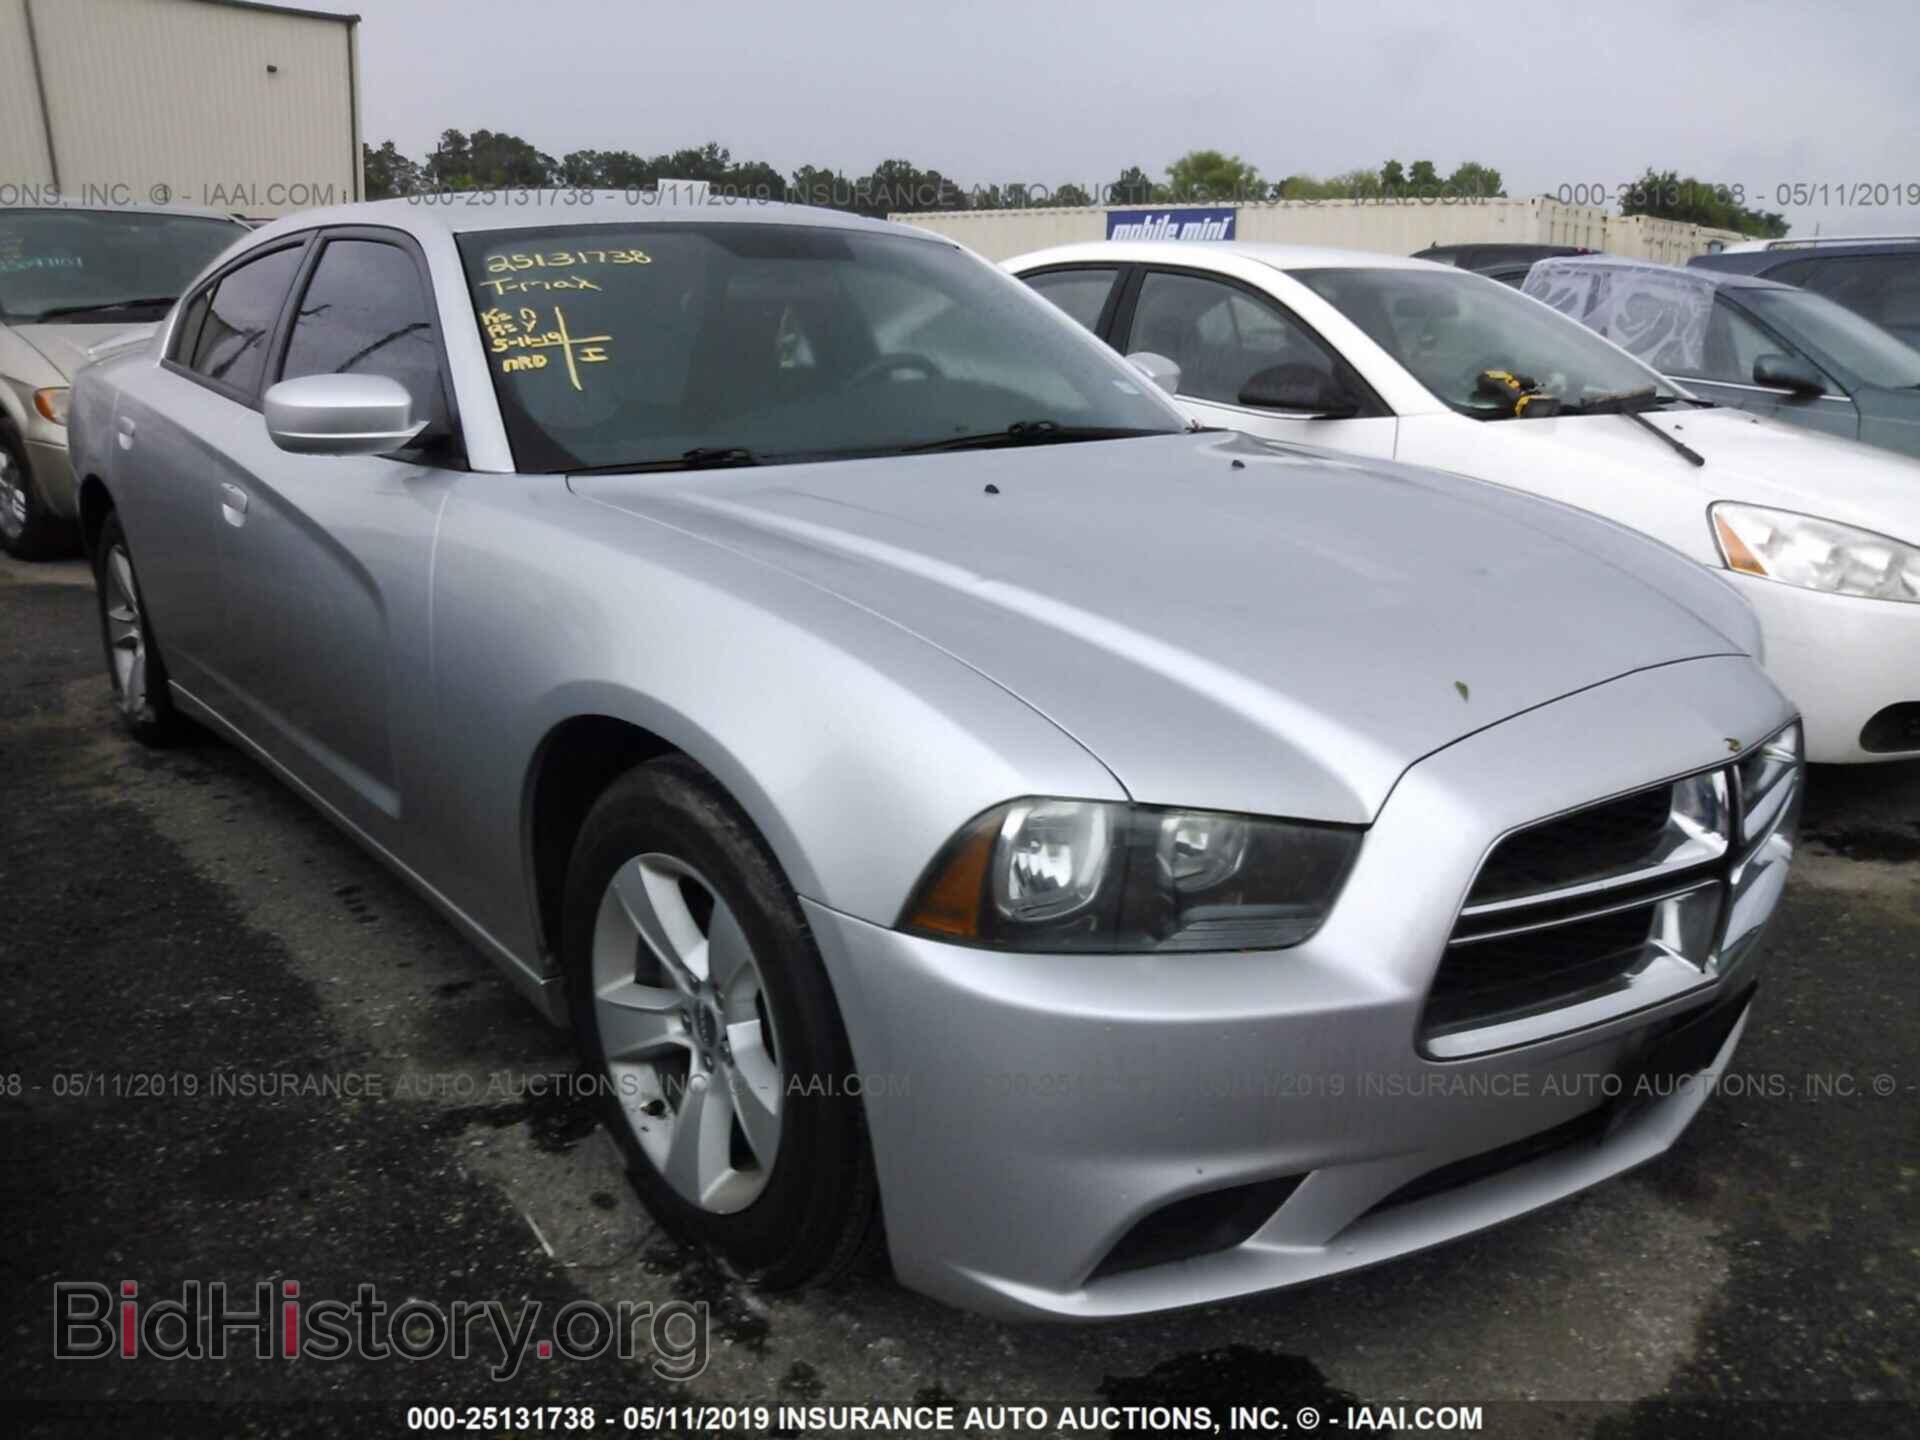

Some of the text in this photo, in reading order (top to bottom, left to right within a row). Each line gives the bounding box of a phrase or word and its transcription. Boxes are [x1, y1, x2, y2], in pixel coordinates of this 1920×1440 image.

[1111, 214, 1230, 240] mobile mini
[487, 249, 652, 272] 25131738
